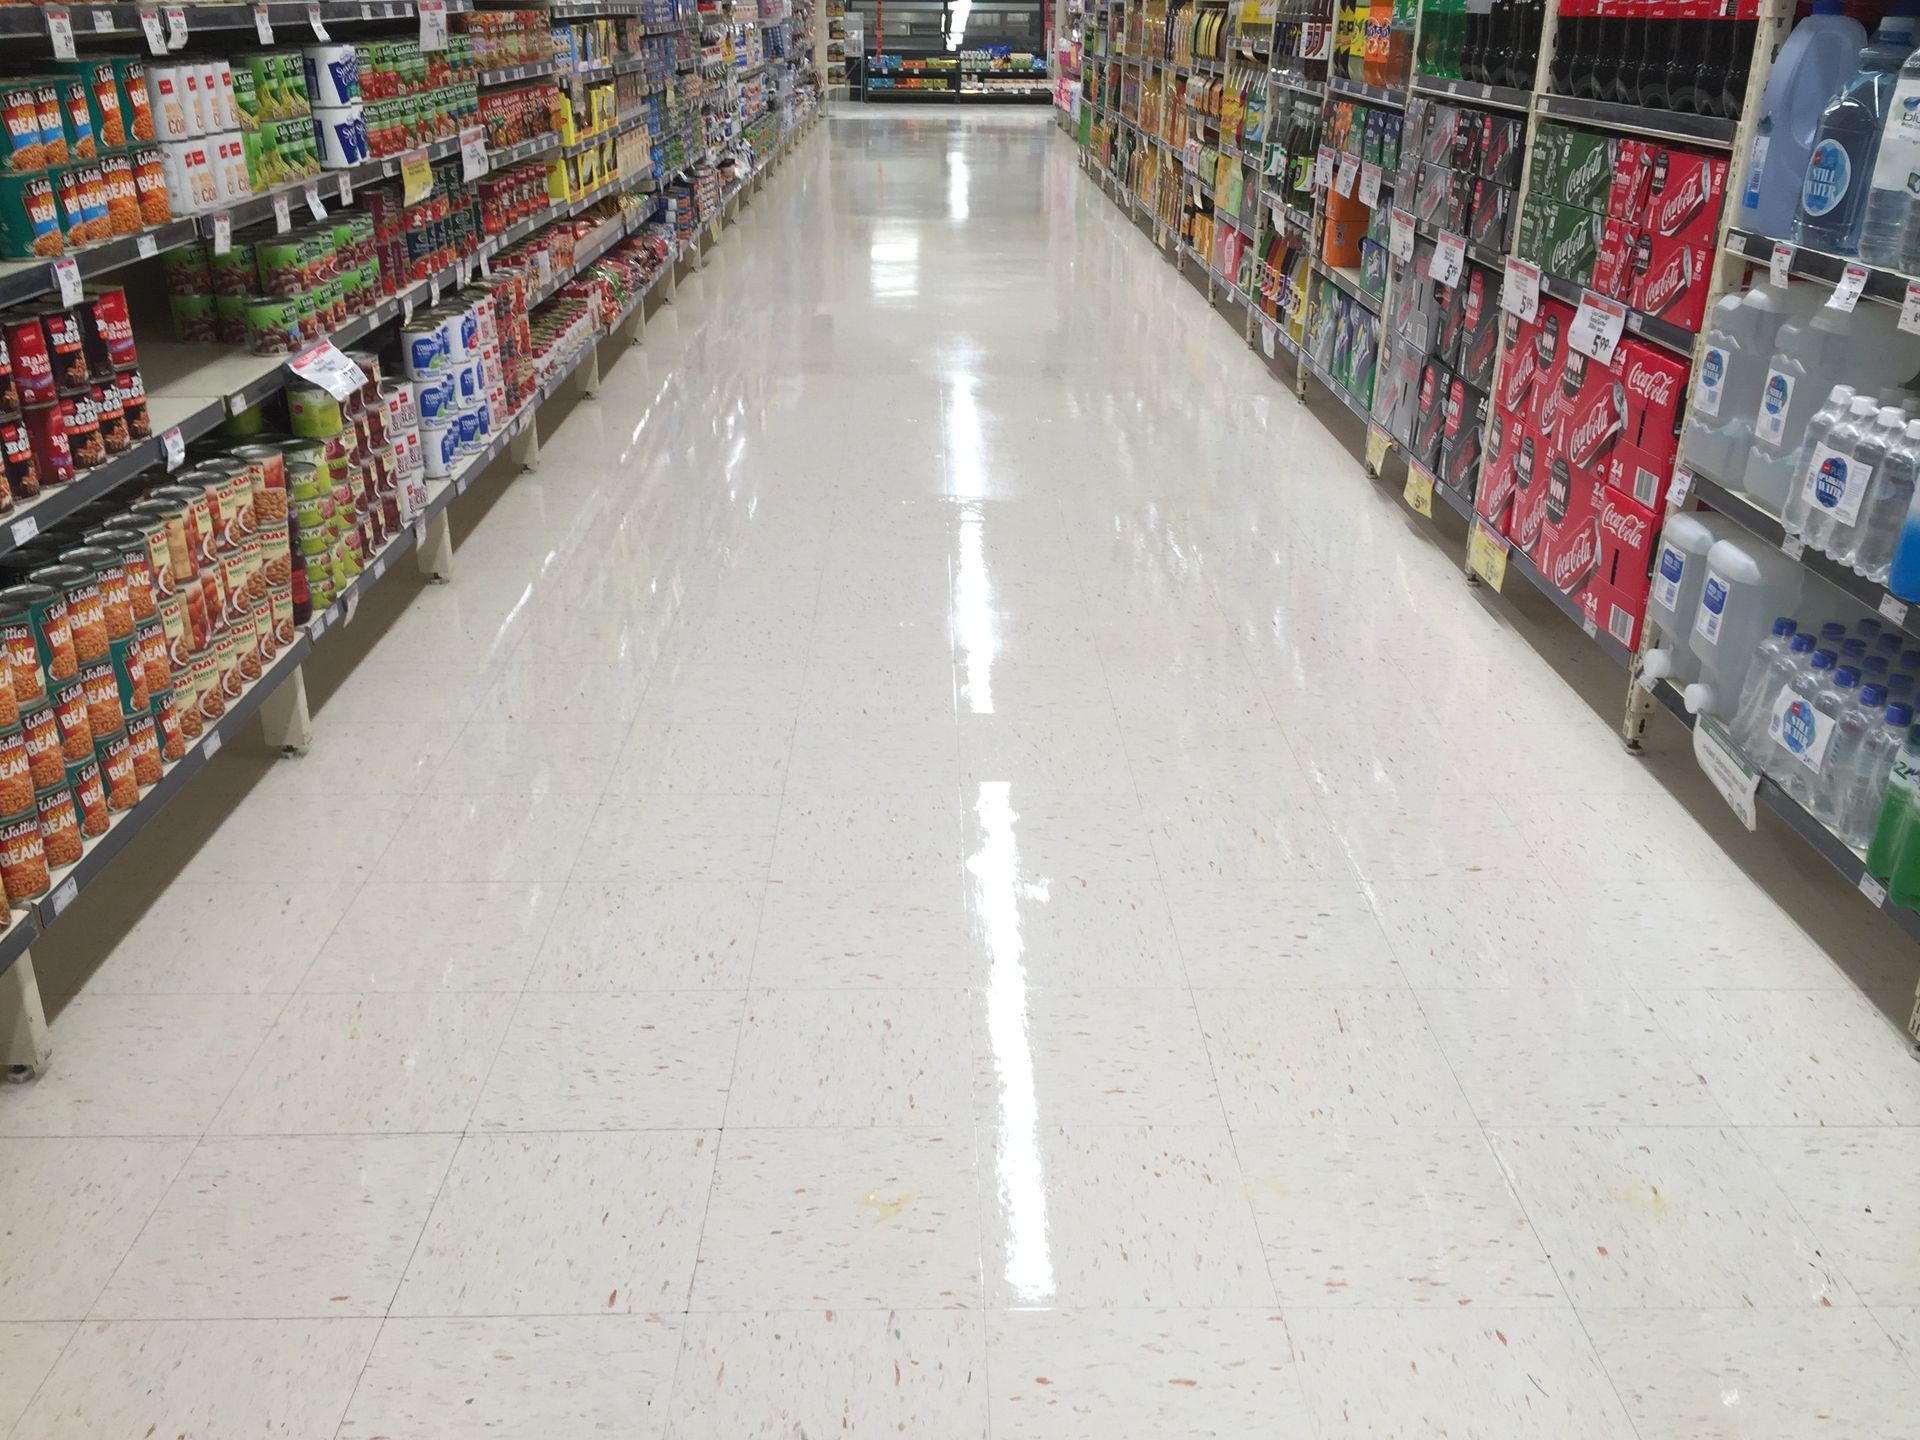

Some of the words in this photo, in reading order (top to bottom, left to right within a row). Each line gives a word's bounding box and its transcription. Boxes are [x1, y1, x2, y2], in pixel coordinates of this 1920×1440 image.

[1564, 145, 1570, 158] 8
[1713, 174, 1721, 186] 8
[1549, 217, 1556, 229] 8
[1695, 260, 1702, 273] 8
[1542, 333, 1556, 352] WIN
[1567, 349, 1584, 371] WIN
[1614, 346, 1627, 364] 24
[1513, 422, 1523, 437] 18
[1611, 459, 1625, 477] 24
[1549, 479, 1567, 502] WIN
[1585, 592, 1599, 611] 24
